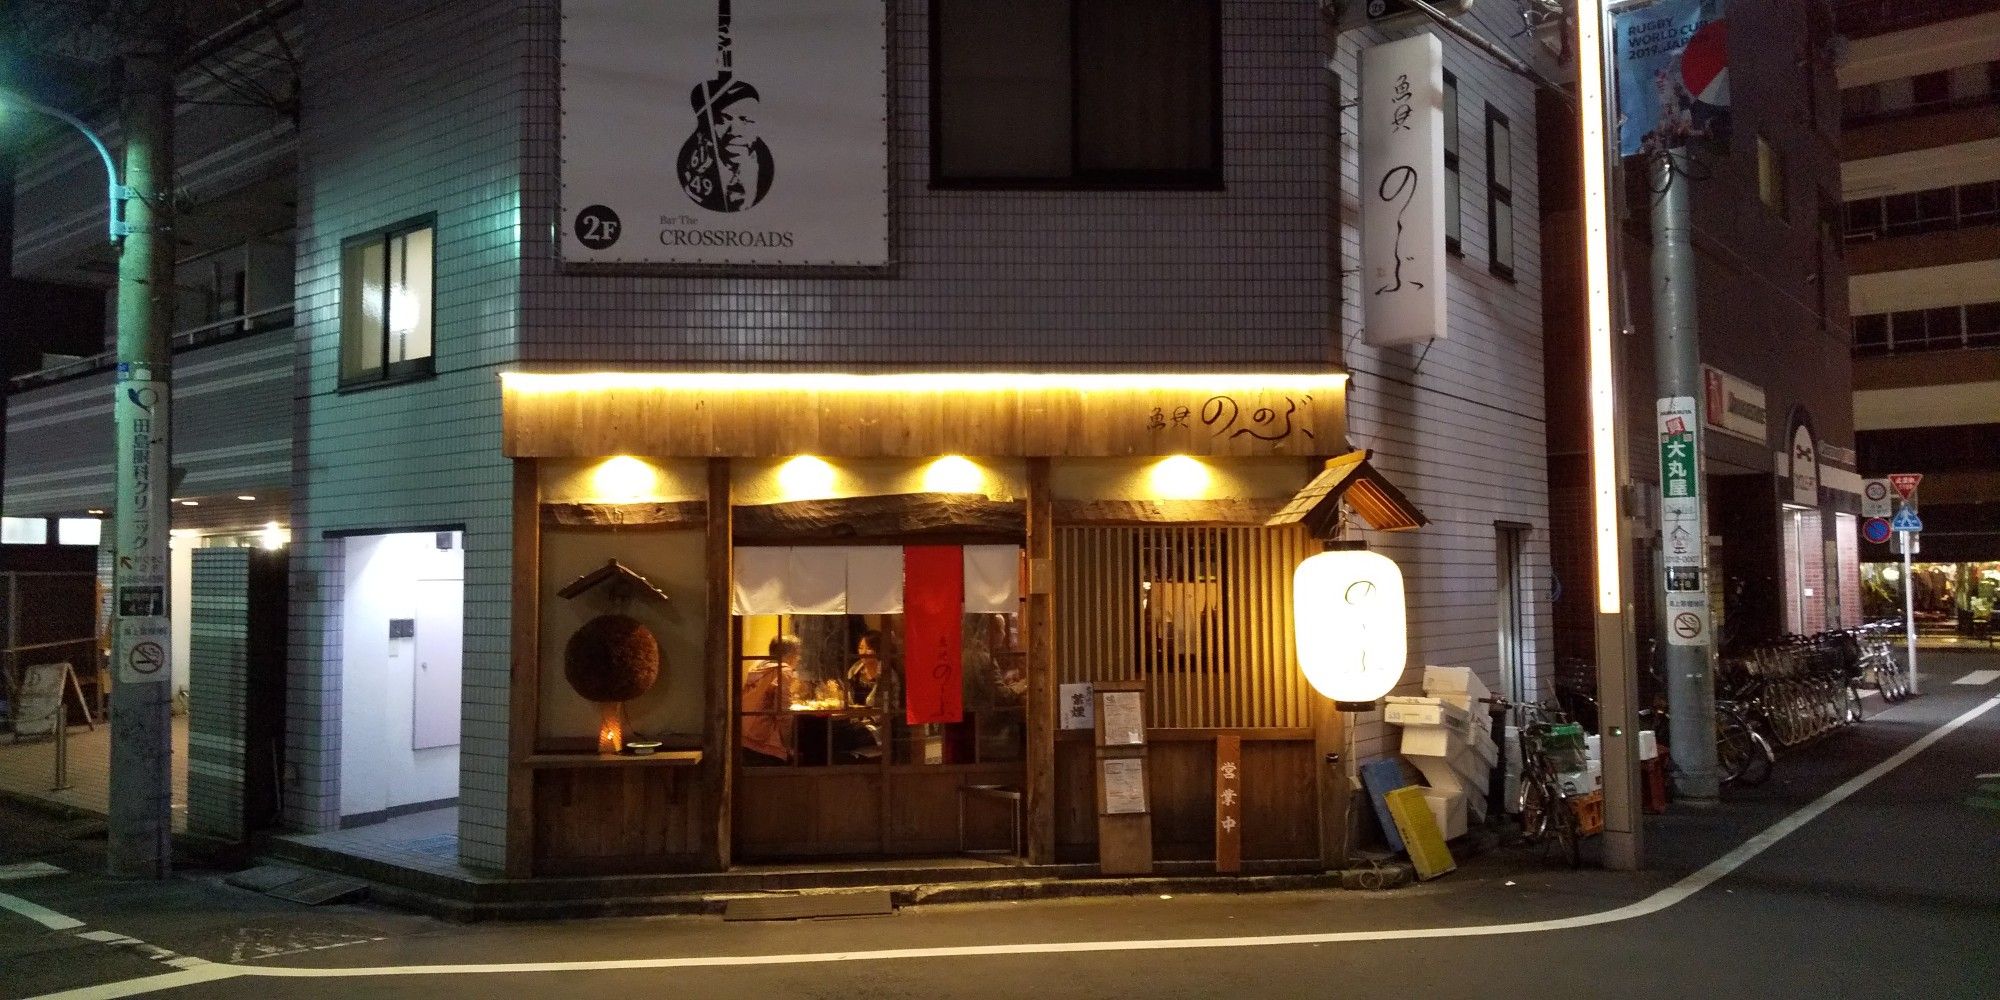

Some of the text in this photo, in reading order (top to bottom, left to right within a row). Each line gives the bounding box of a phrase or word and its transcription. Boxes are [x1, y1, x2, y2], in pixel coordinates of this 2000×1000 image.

[1629, 17, 1673, 36] RUGBY
[1629, 28, 1677, 47] WORLD
[582, 215, 618, 241] 2F
[660, 215, 698, 225] Bar The
[659, 229, 794, 248] CROSSROADS
[1667, 442, 1687, 497] 大丸屋
[1221, 761, 1238, 834] 営業中
